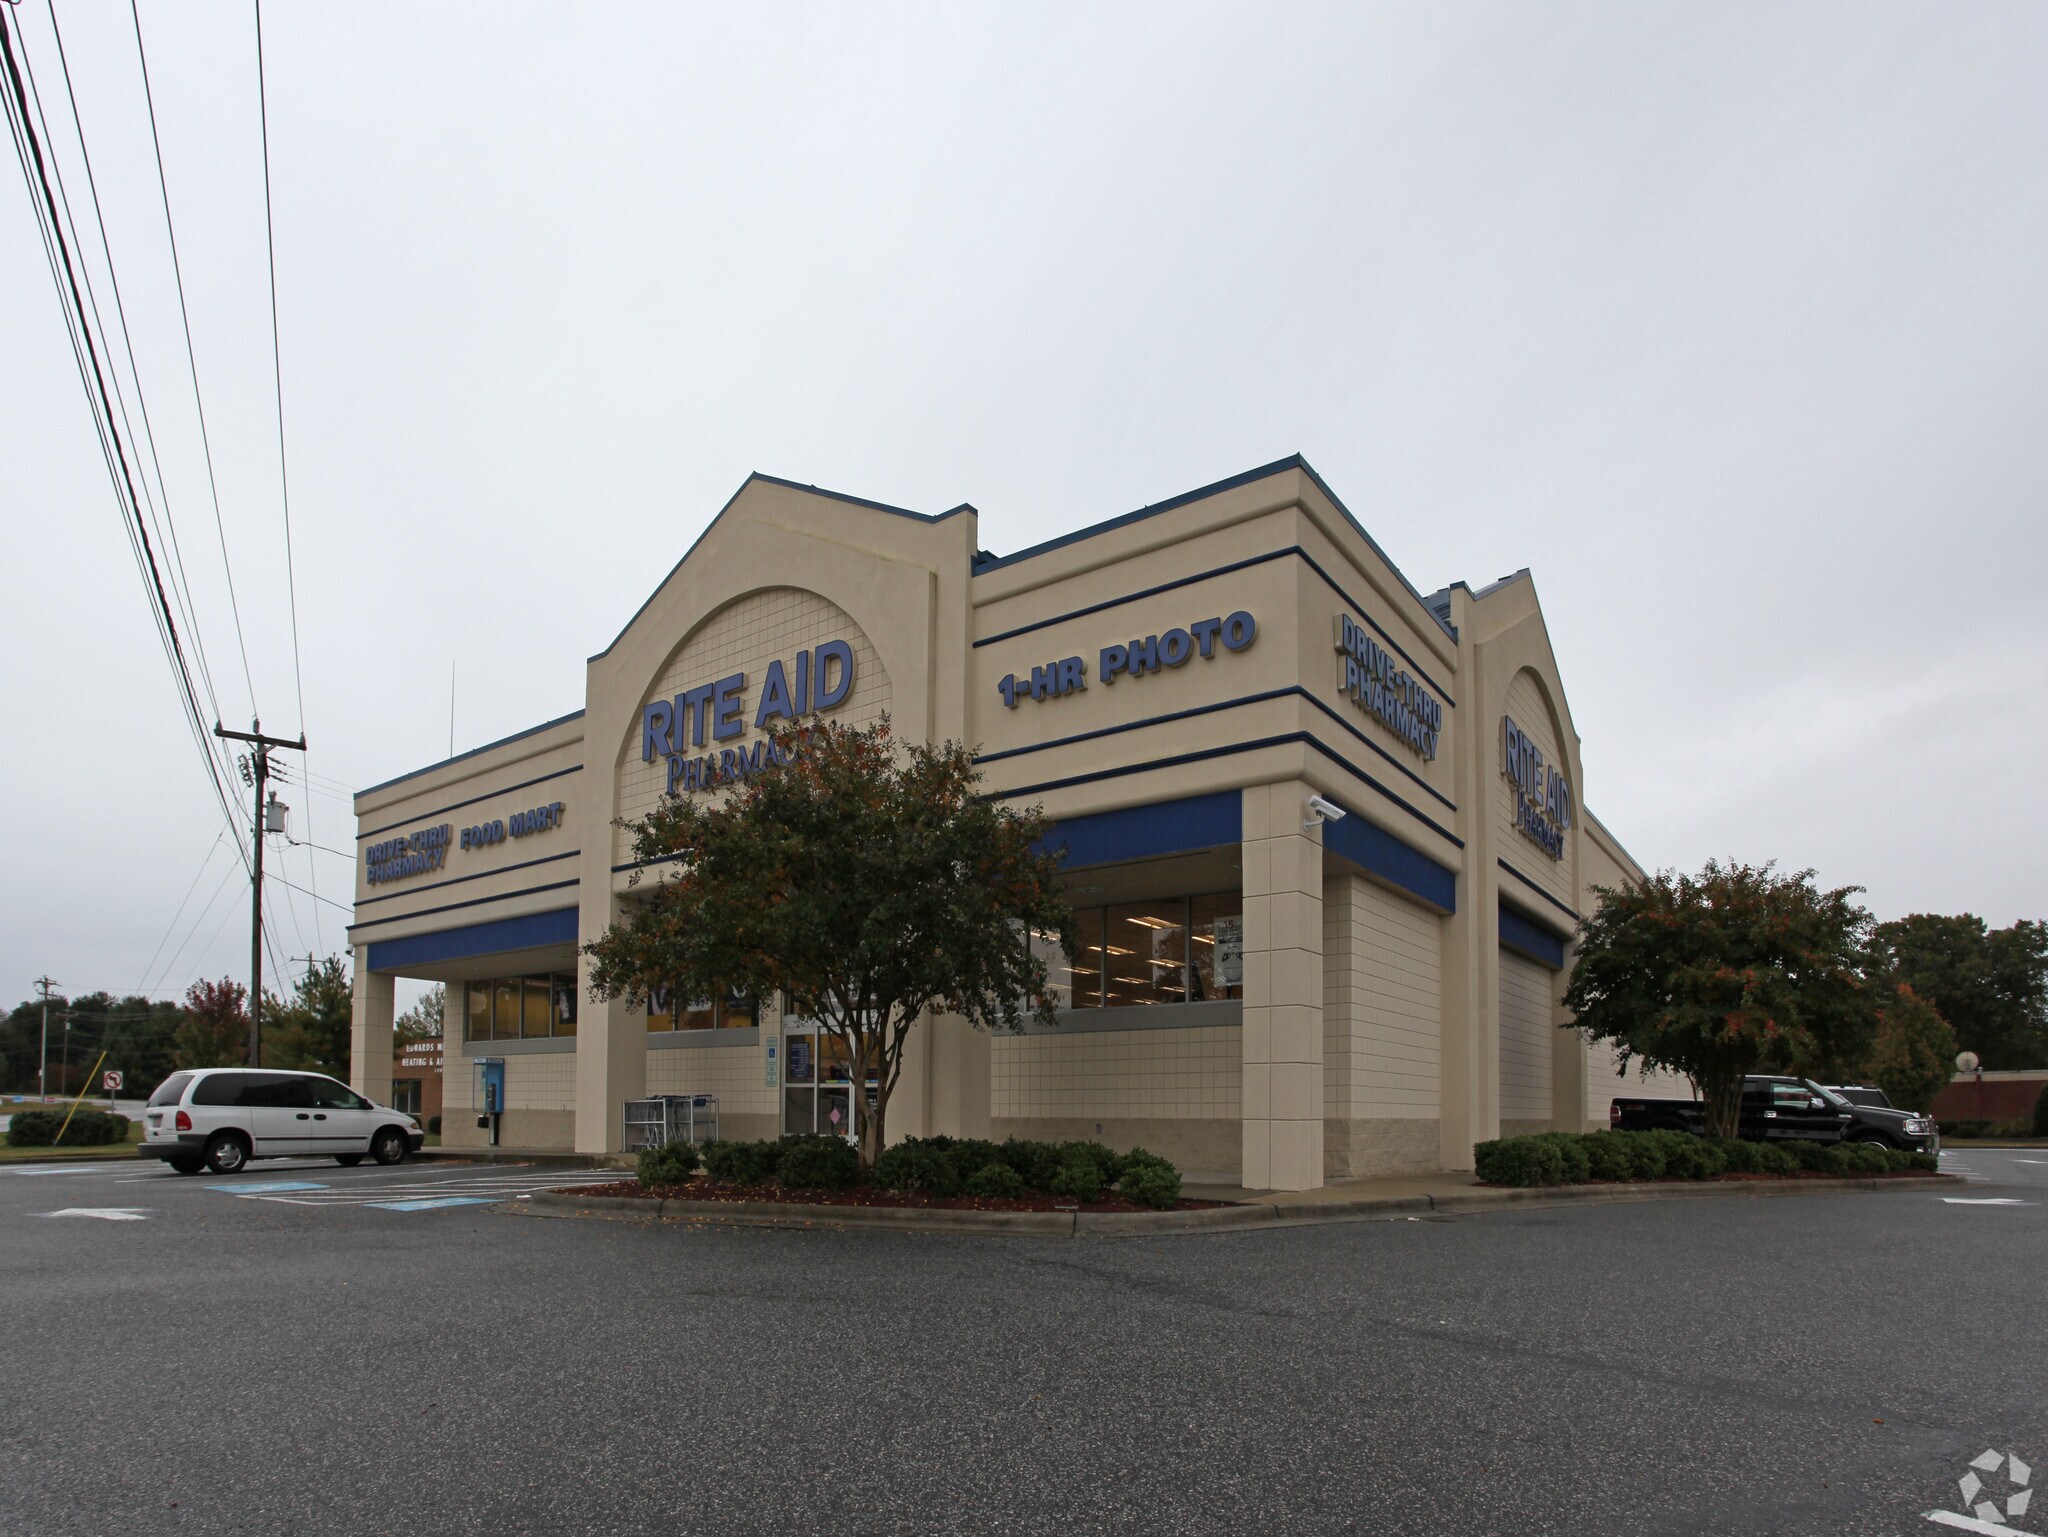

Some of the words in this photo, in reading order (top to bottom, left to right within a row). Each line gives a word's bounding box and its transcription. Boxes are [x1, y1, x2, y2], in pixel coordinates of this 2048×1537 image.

[998, 656, 1086, 708] 1-HR
[1100, 610, 1258, 685] PHOTO
[1339, 613, 1441, 732] DRIVE-THRU
[642, 672, 747, 762] RITE
[754, 639, 857, 728] AID
[1344, 655, 1438, 761] PHARMACY
[1503, 715, 1543, 806] RITE
[1546, 764, 1571, 830] AID
[366, 823, 451, 867] DRIVE-THRU
[460, 819, 505, 851] FOOD
[509, 801, 564, 837] MART
[1516, 788, 1564, 861] PHARMACY
[366, 847, 445, 886] PHARMACY
[401, 1058, 427, 1066] HEATING
[429, 1057, 434, 1066] &
[406, 1043, 434, 1052] EDWARDS
